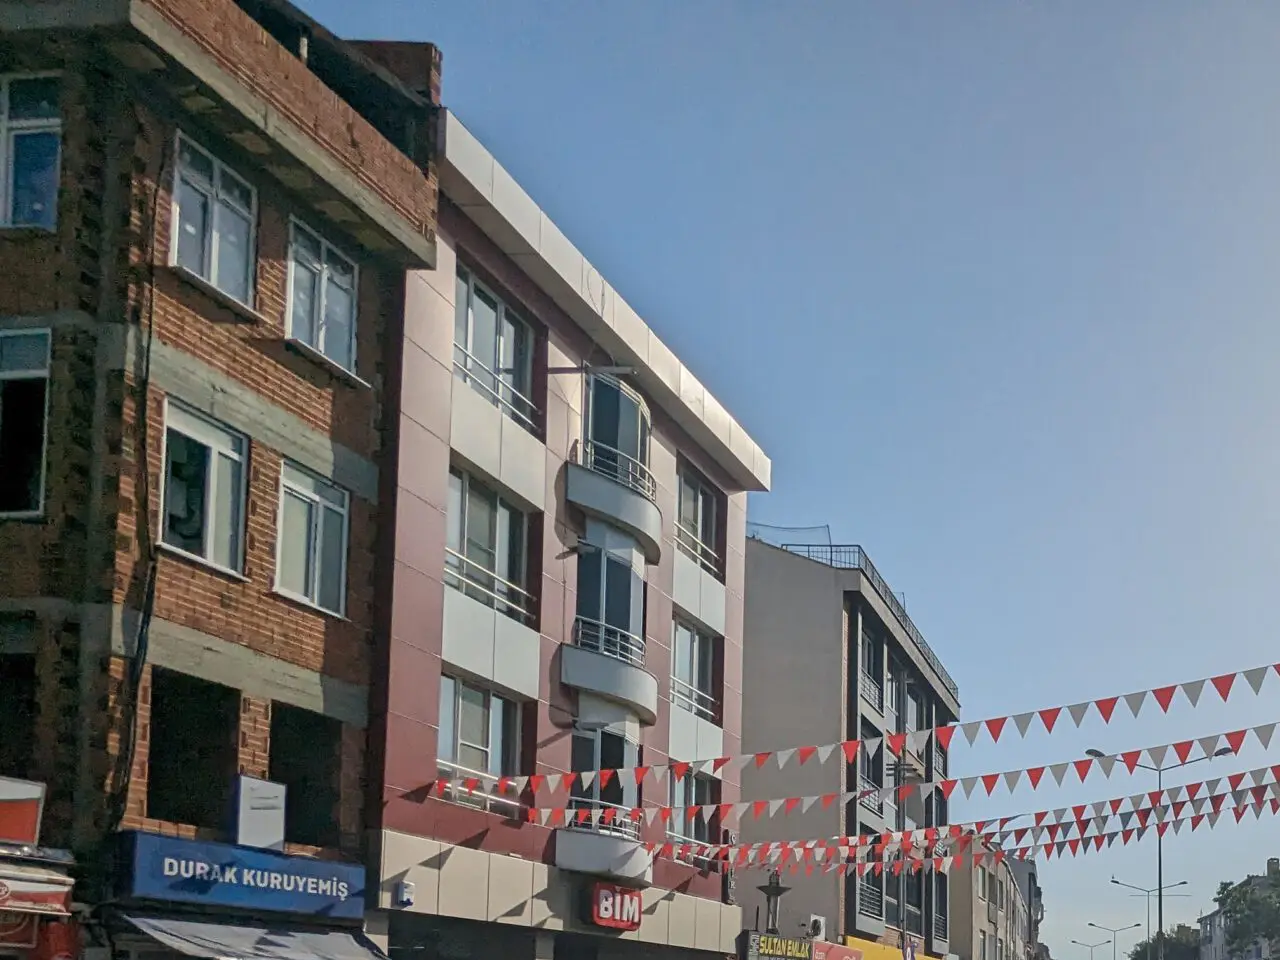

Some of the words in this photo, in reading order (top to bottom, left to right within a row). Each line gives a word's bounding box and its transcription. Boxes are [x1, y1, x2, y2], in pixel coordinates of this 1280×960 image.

[163, 857, 238, 884] DURAK
[242, 868, 349, 901] KURUYEMİŞ
[759, 935, 787, 956] SULTAN
